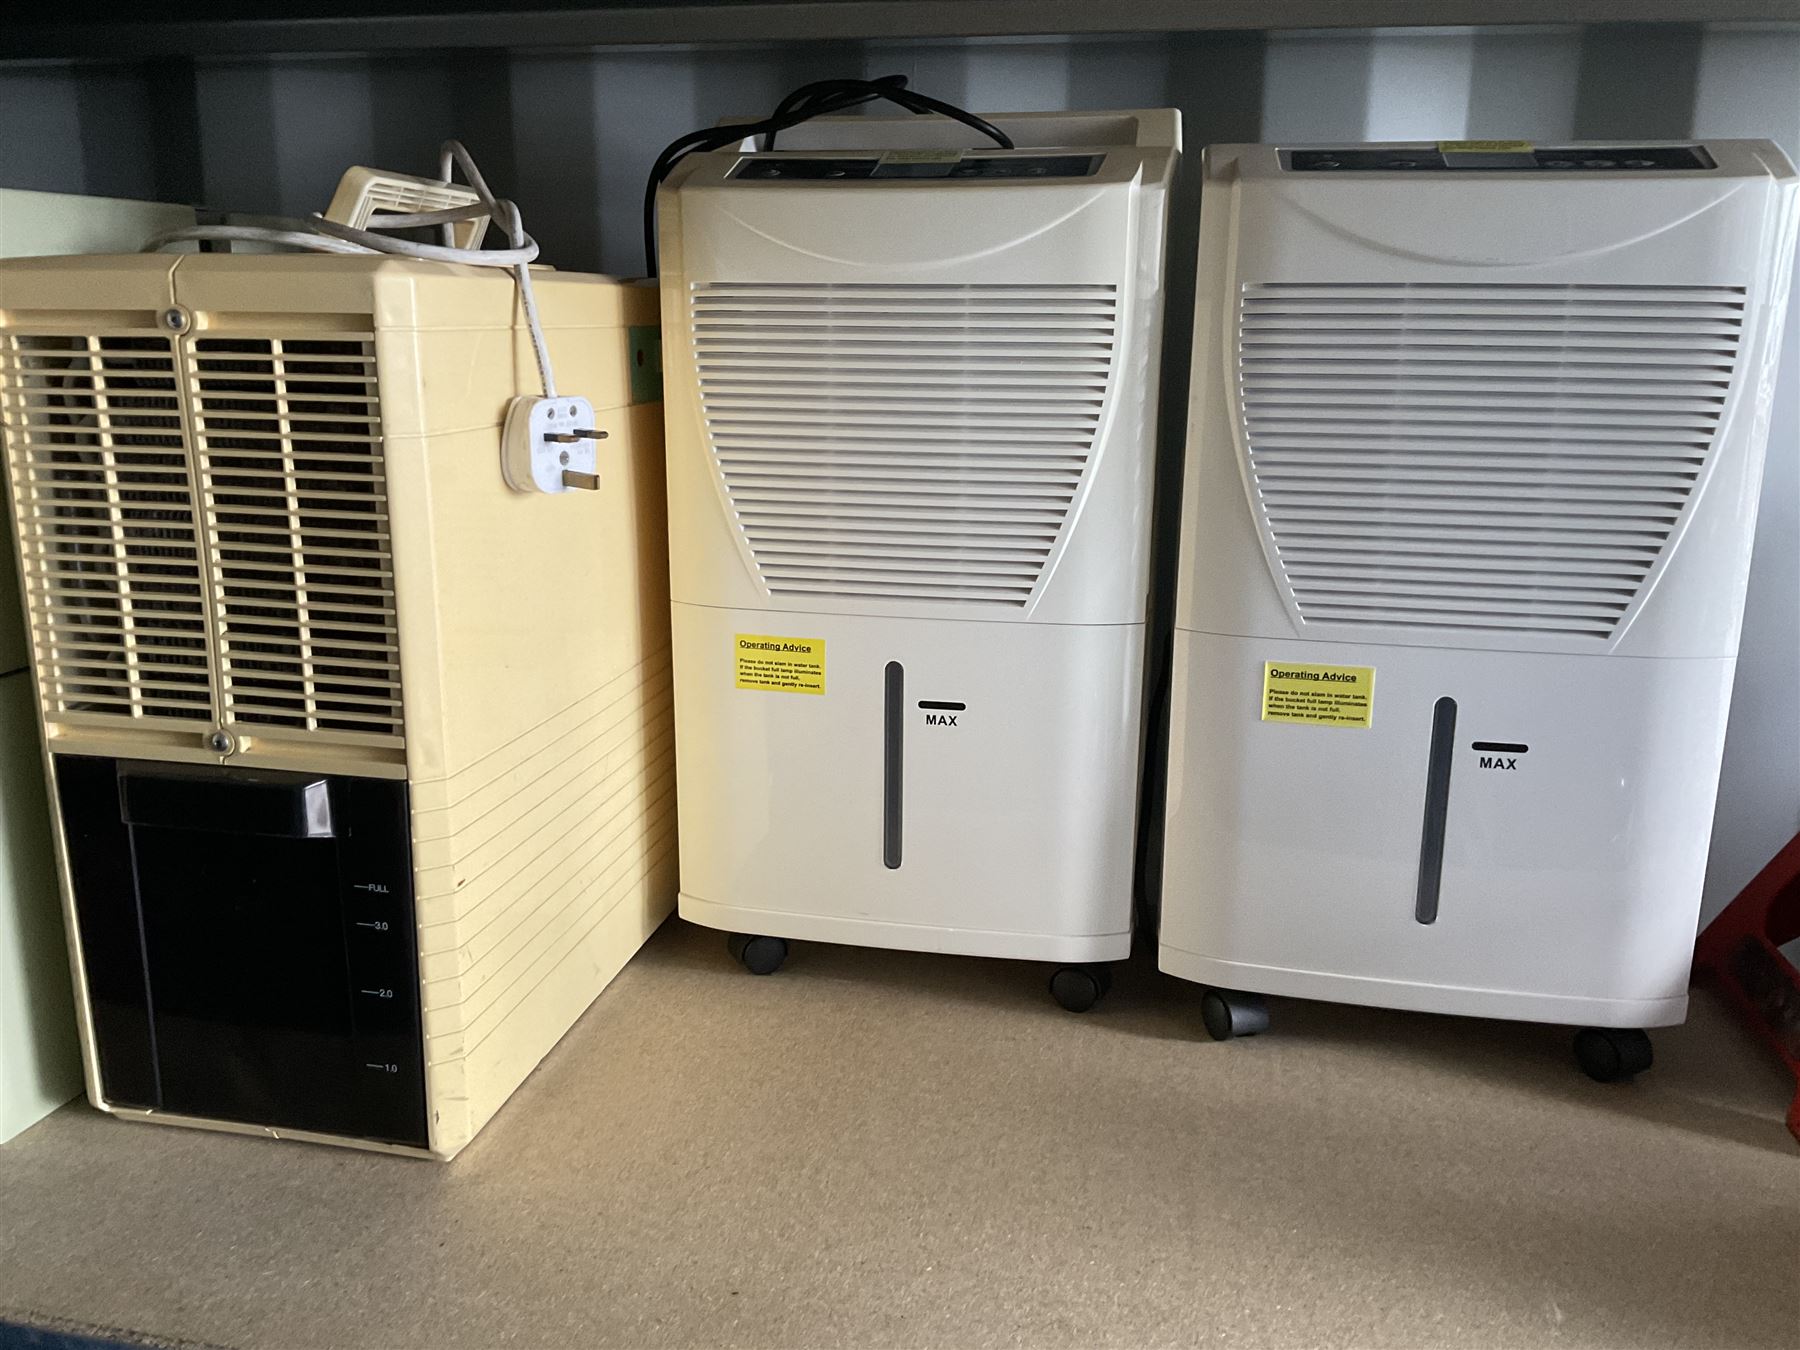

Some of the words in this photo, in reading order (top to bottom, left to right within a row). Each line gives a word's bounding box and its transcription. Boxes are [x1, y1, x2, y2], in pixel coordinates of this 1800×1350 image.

[740, 640, 780, 651] Operating
[783, 644, 811, 652] Advice
[1271, 669, 1319, 681] Operating
[1322, 672, 1356, 682] Advice
[926, 714, 958, 726] MAX
[1479, 757, 1516, 770] MAX
[368, 884, 389, 893] FULL
[374, 921, 388, 930] 3.0
[379, 989, 393, 998] 2.0
[385, 1063, 397, 1072] 1.0
